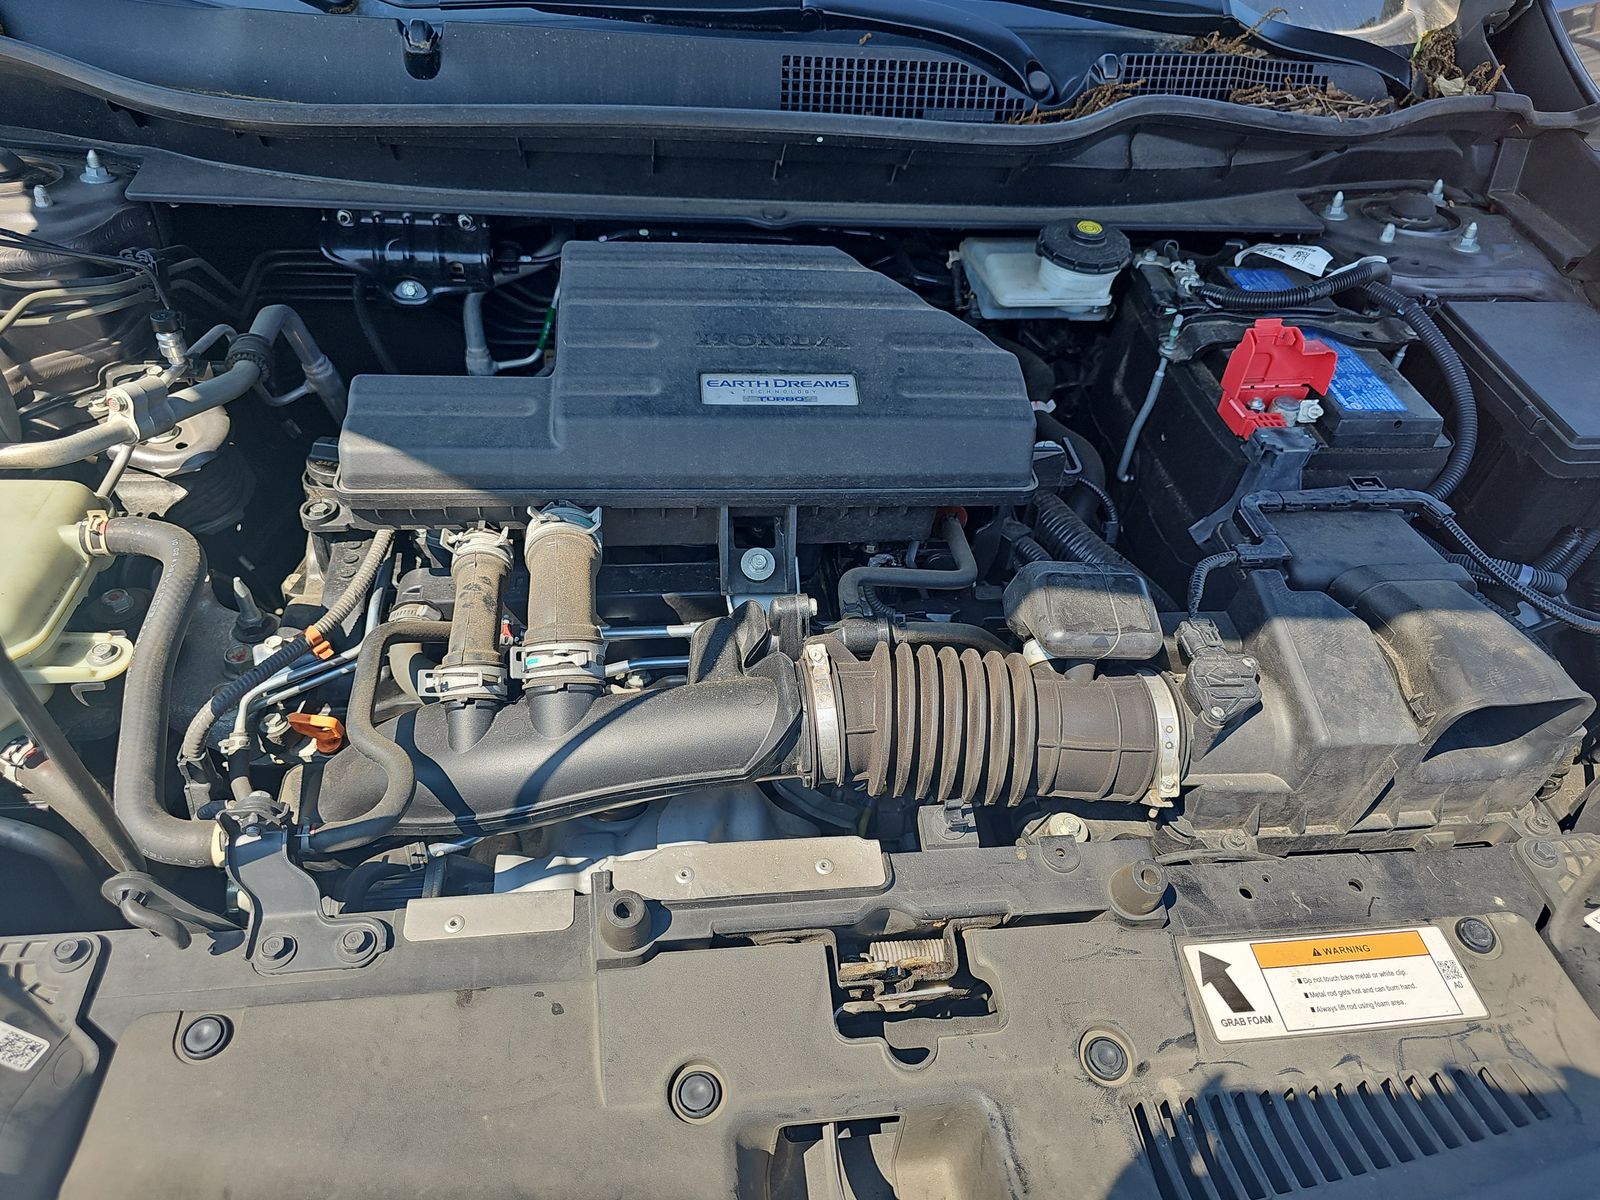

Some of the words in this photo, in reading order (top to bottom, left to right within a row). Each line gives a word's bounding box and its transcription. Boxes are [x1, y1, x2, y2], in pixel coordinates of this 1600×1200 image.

[696, 333, 850, 348] HONDA
[706, 380, 769, 388] EARTH
[772, 379, 850, 388] DREAMS
[1322, 944, 1371, 956] WARNING
[1302, 976, 1313, 984] Do
[1309, 990, 1326, 998] Metal
[1327, 989, 1337, 997] rod
[1338, 989, 1351, 998] gets
[1385, 984, 1400, 992] burn
[1400, 982, 1418, 990] hand.
[1316, 1004, 1338, 1013] Always
[1337, 1003, 1346, 1011] lift
[1357, 1001, 1375, 1010] using
[1220, 1017, 1247, 1027] GRAB
[1246, 1014, 1273, 1025] FOAM
